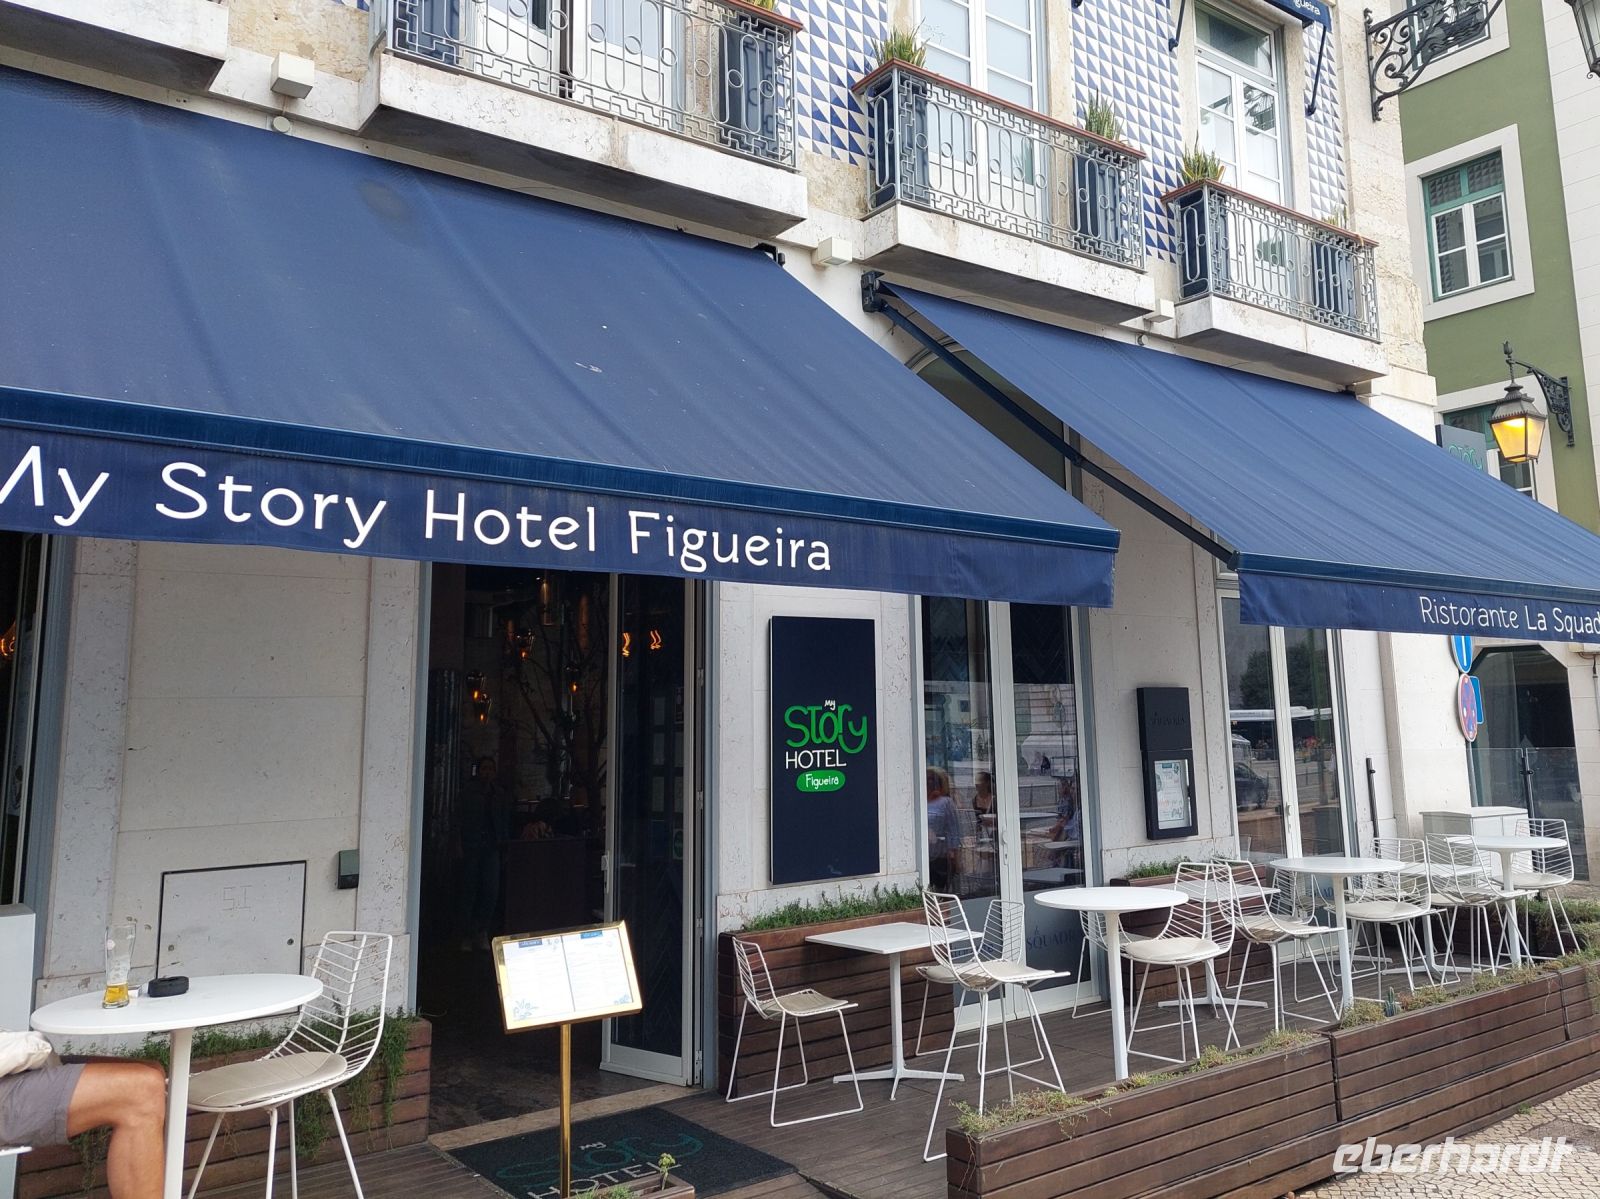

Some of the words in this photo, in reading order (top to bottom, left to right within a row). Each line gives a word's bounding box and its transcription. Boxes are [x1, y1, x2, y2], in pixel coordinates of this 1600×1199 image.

[155, 461, 387, 549] Story
[424, 489, 596, 553] Hotel
[628, 509, 832, 573] Figueira
[1419, 596, 1520, 629] Ristorante
[1524, 605, 1548, 631] La
[785, 749, 846, 769] HOTEL
[805, 773, 839, 790] Figueira
